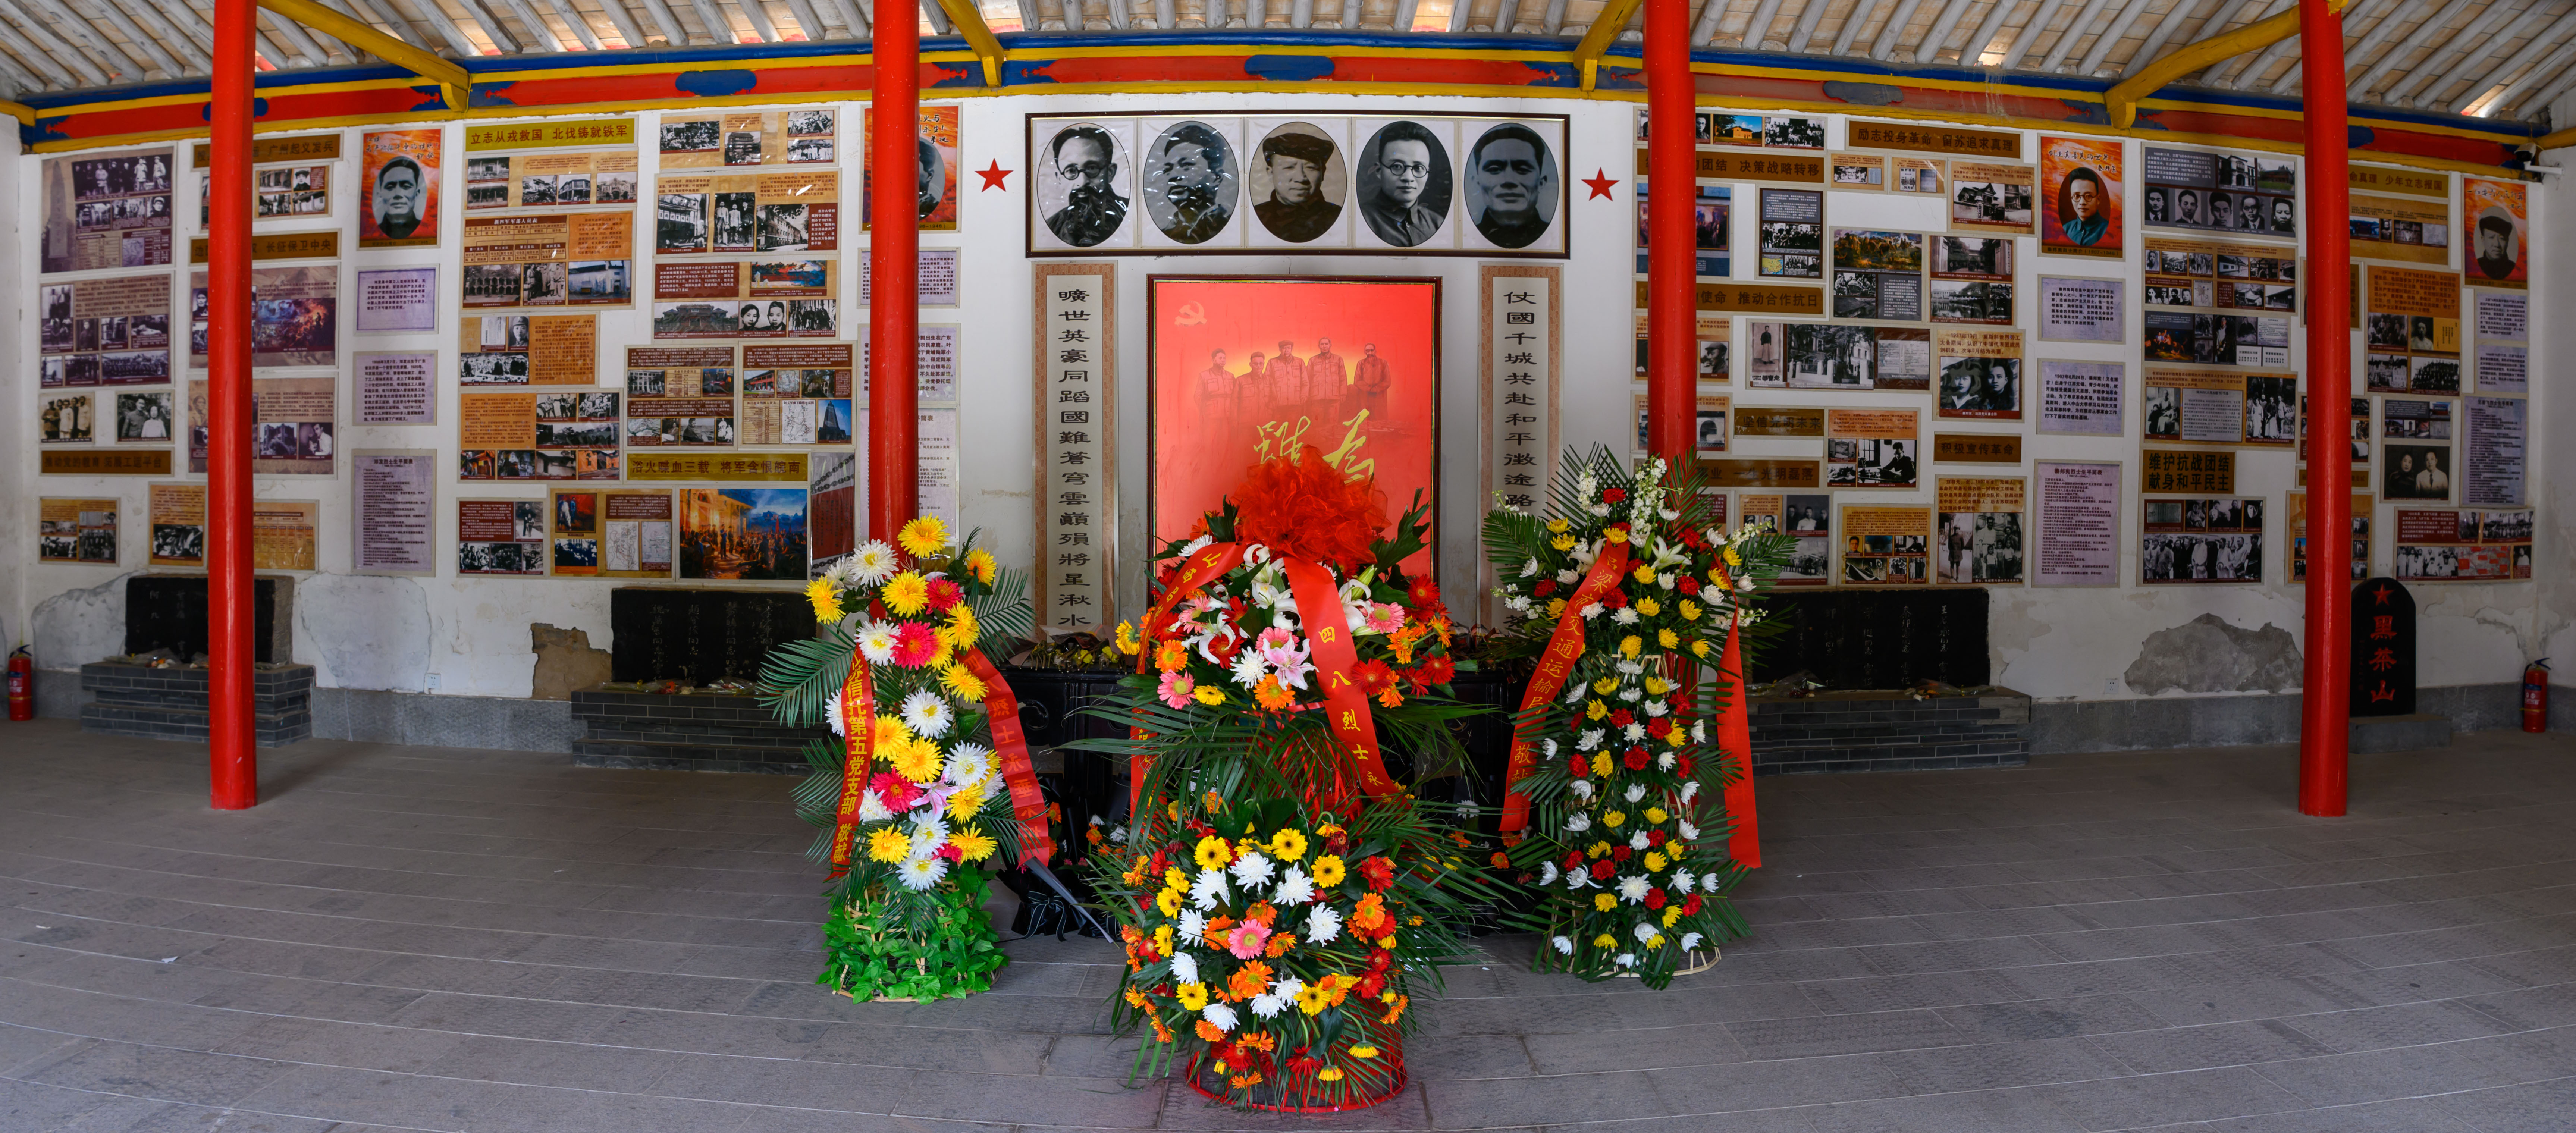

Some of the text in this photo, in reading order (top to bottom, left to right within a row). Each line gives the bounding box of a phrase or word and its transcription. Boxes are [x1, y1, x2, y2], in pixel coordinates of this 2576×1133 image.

[471, 125, 628, 145] 立志从戎救国 北伐铸就铁军
[1858, 128, 2013, 152] 励志投身革命 留苏追求真理
[268, 141, 333, 157] 广州起义发兵
[1739, 159, 1820, 176] 决策战略转移
[2385, 174, 2442, 191] 少年立志报国
[266, 238, 331, 253] 长征保卫中央
[1738, 291, 1818, 307] 推动合作抗日
[1743, 415, 1822, 430] 坚信光明未来
[1941, 442, 2014, 456] 积极宣传革命
[632, 460, 800, 474] 浴火喋血三载 将军含恨皖南
[2148, 452, 2230, 473] 维护抗战团结
[2148, 473, 2230, 492] 献身和平民主
[2369, 615, 2397, 703] 黑茶山
[833, 823, 853, 863] 敬献
